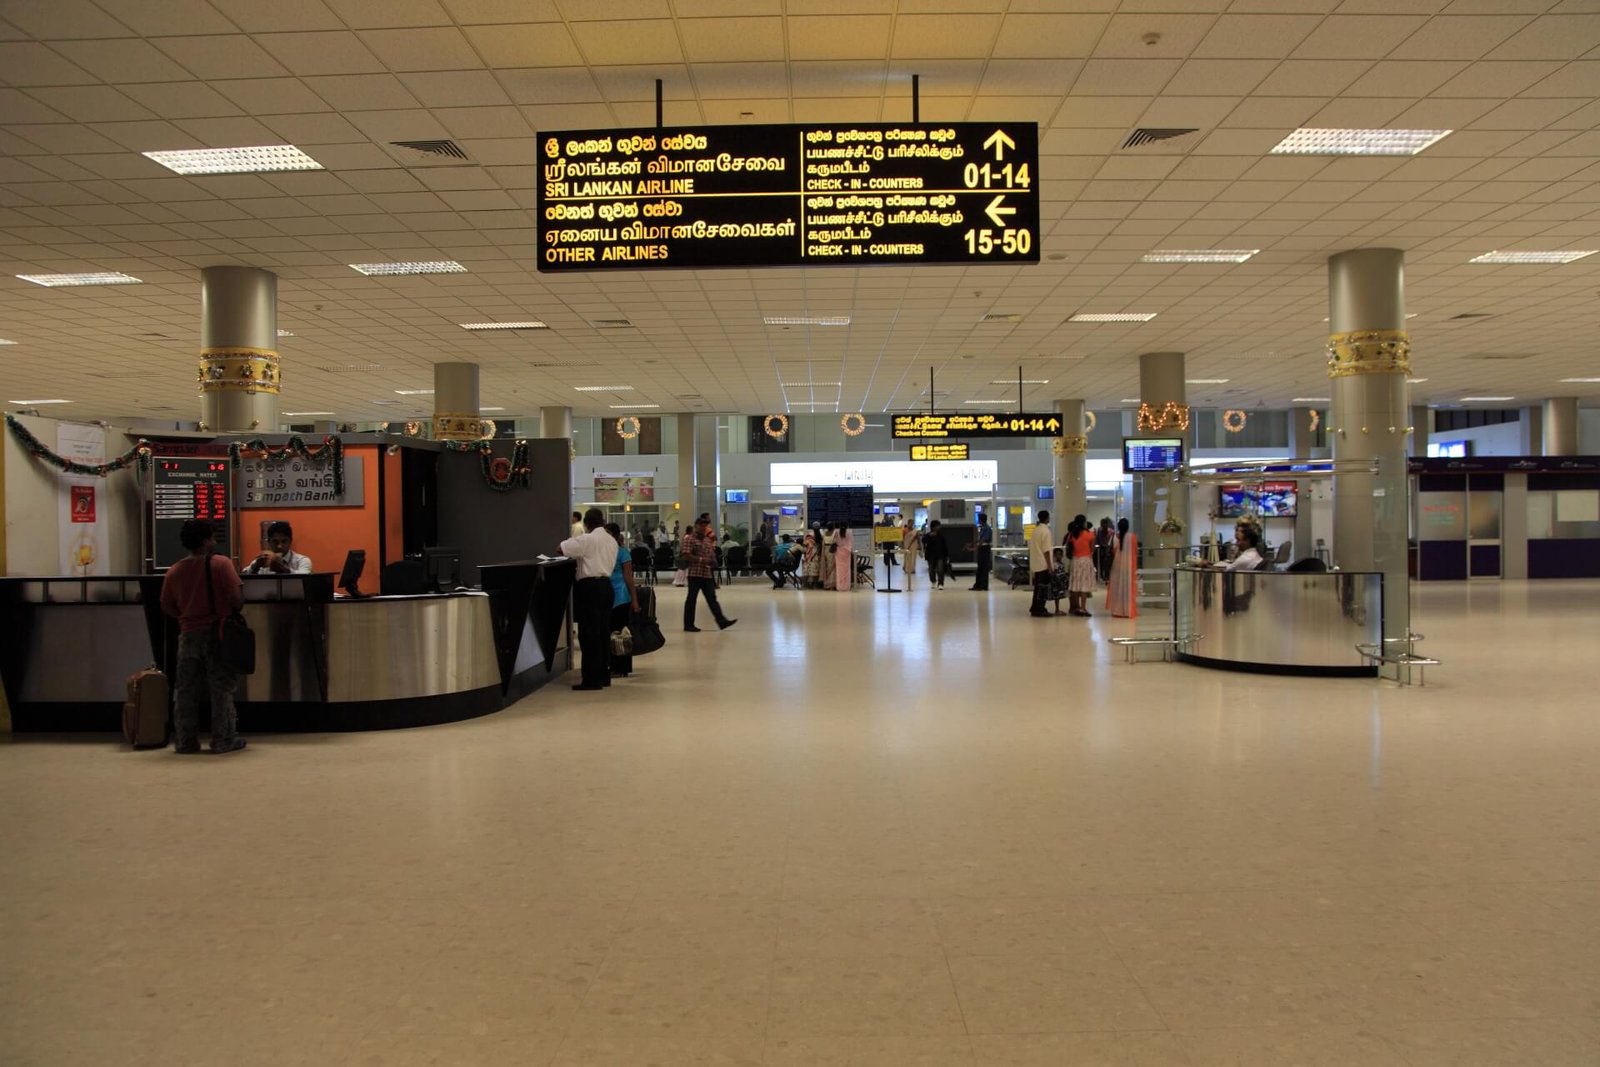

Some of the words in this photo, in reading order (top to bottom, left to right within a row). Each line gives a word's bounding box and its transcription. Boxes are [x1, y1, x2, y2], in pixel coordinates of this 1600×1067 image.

[807, 130, 833, 143] ගුවන්
[565, 137, 612, 156] ලංකන්
[617, 135, 657, 155] ගුවන්
[661, 134, 707, 151] සේවය
[807, 146, 884, 160] பயணச்சீட்டு
[888, 144, 964, 159] பரிசீலிக்கும்
[647, 153, 785, 174] விமானசேவை
[807, 161, 870, 176] கருமபீடம்
[964, 163, 1031, 188] 01-14
[545, 182, 569, 197] SRI
[574, 181, 633, 196] LANKAN
[637, 179, 694, 195] AIRLINE
[807, 180, 841, 190] CHECK
[869, 178, 923, 189] COUNTERS
[807, 196, 833, 209] ගුවන්
[545, 203, 594, 220] වෙනත්
[599, 202, 639, 222] ගුවන්
[643, 200, 682, 217] සේවා
[807, 212, 884, 226] பயணச்சீட்டு
[888, 210, 964, 226] பரிசீலிக்கும்
[545, 227, 617, 247] ஏனைய
[621, 218, 796, 241] விமானசேவைகள்
[808, 227, 872, 242] கருமபீடம்
[964, 229, 1031, 254] 15-50
[546, 248, 595, 263] OTHER
[602, 245, 668, 261] AIRLINES
[808, 245, 843, 256] CHECK
[871, 244, 924, 254] COUNTERS
[1010, 419, 1044, 431] 01-14
